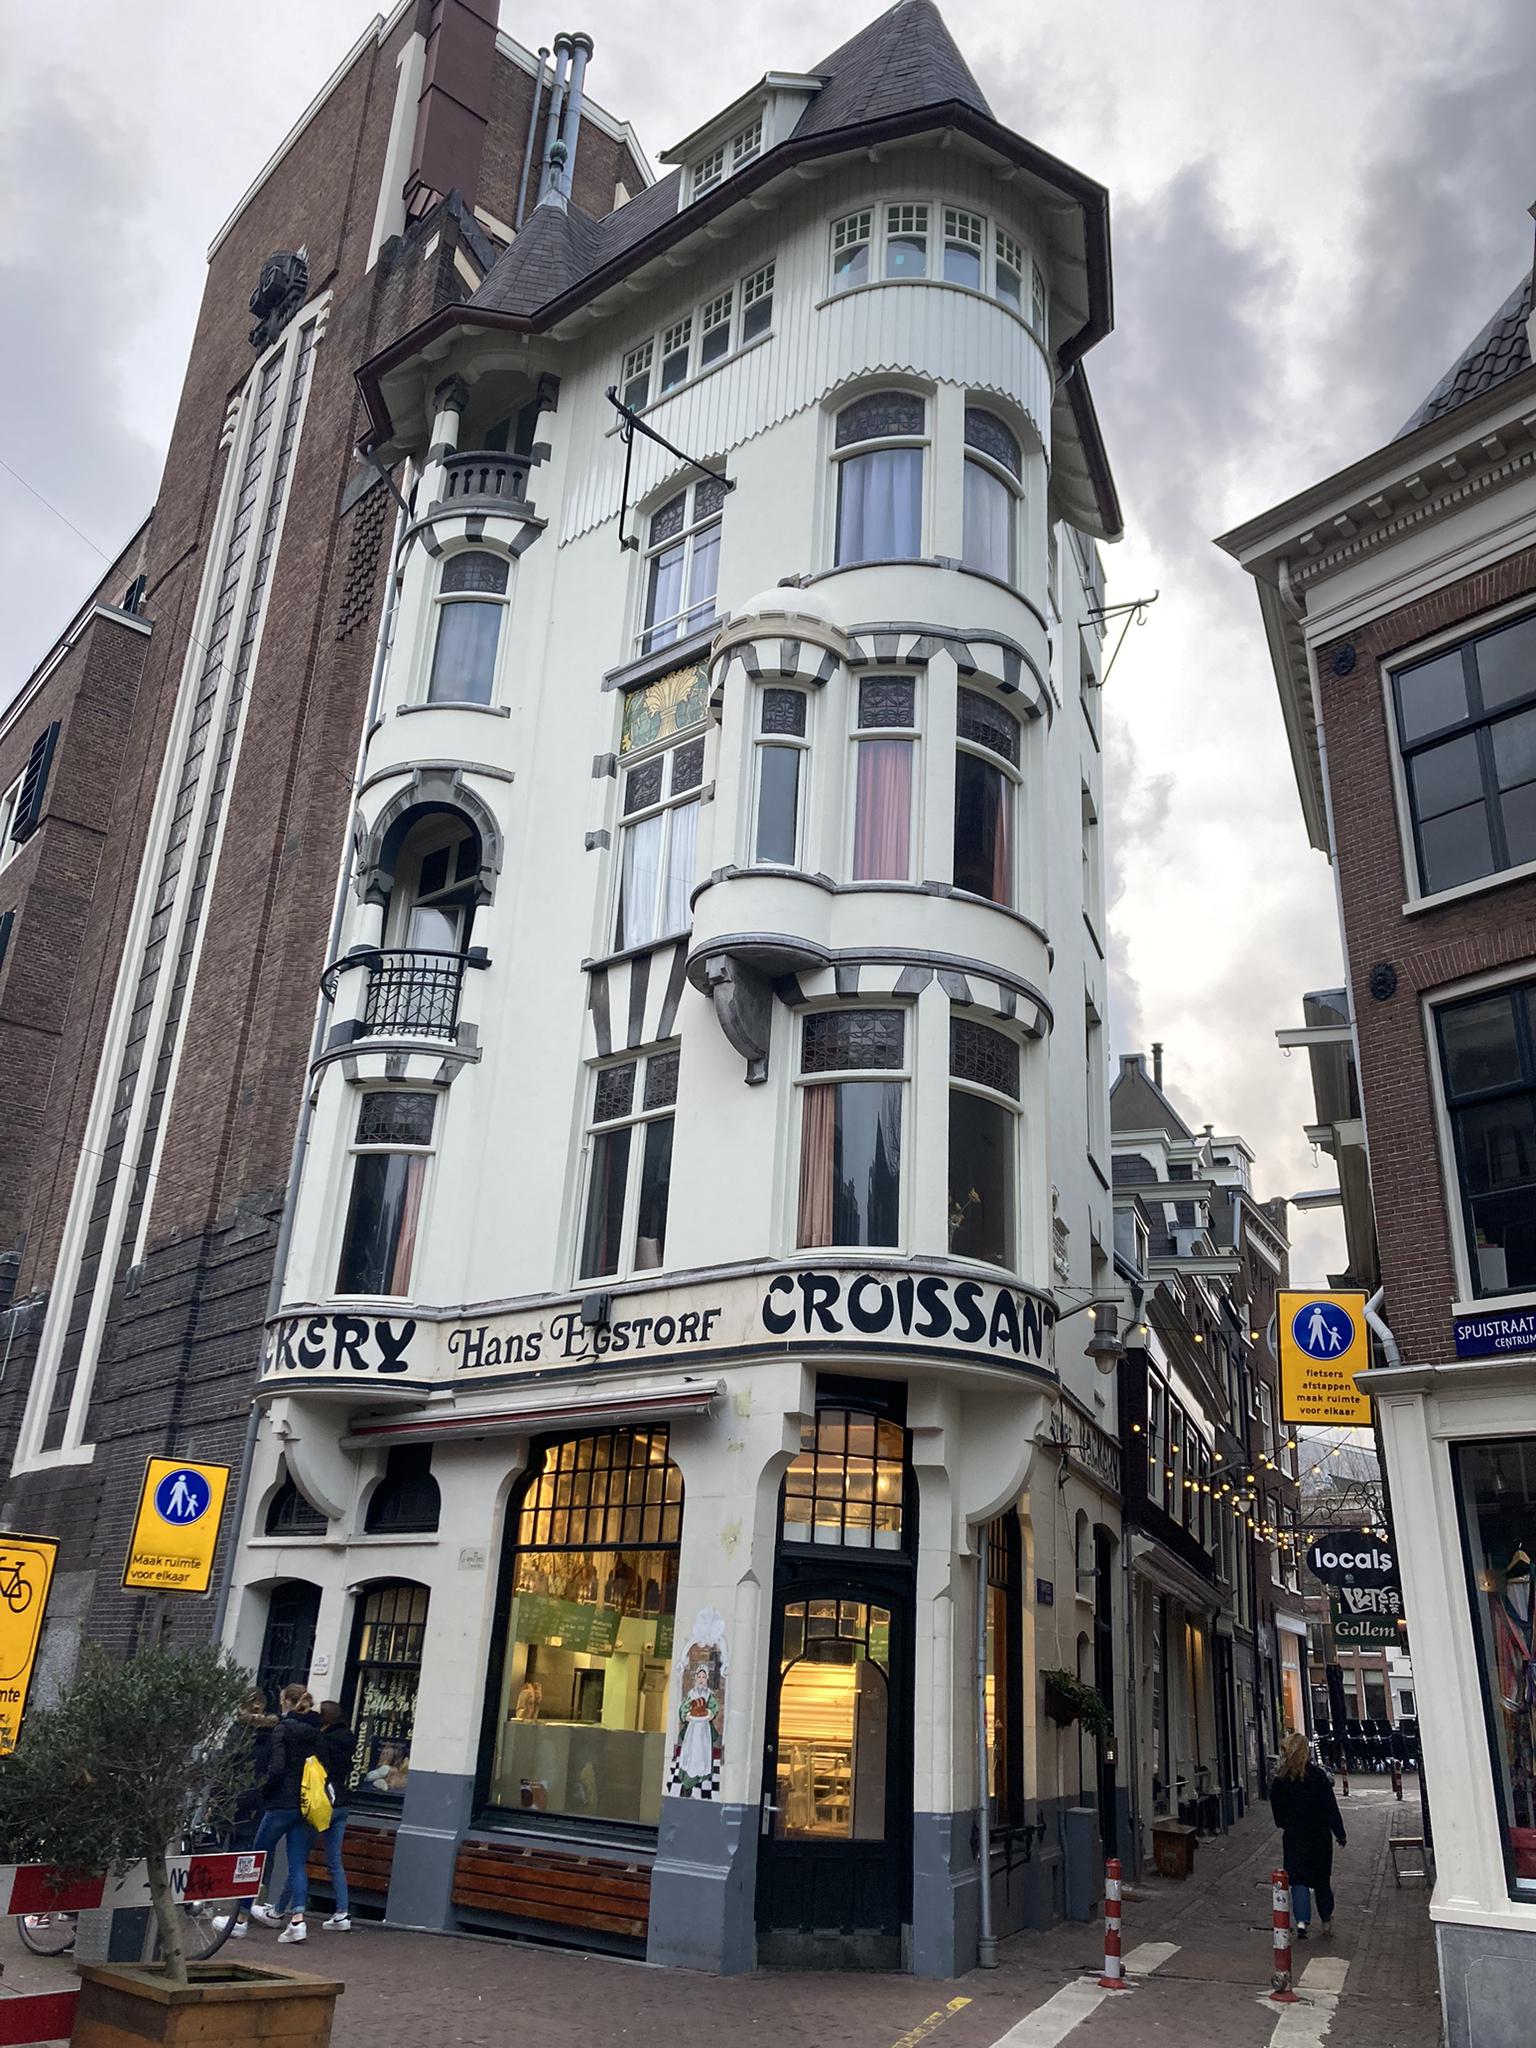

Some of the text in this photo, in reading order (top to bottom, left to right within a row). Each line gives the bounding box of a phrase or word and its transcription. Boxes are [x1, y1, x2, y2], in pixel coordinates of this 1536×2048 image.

[1458, 1316, 1535, 1340] SPUISTRAAT
[448, 1326, 543, 1369] Hans
[1495, 1334, 1536, 1349] CENTRUM
[1306, 1369, 1344, 1378] fietsers
[1302, 1382, 1351, 1391] afstappen
[1327, 1396, 1361, 1404] ruimte
[1324, 1408, 1355, 1416] elkaar
[132, 1555, 201, 1569] Maak ruimte
[1315, 1548, 1393, 1572] locals
[131, 1571, 190, 1581] voor elkaar
[1335, 1621, 1396, 1637] Gollem
